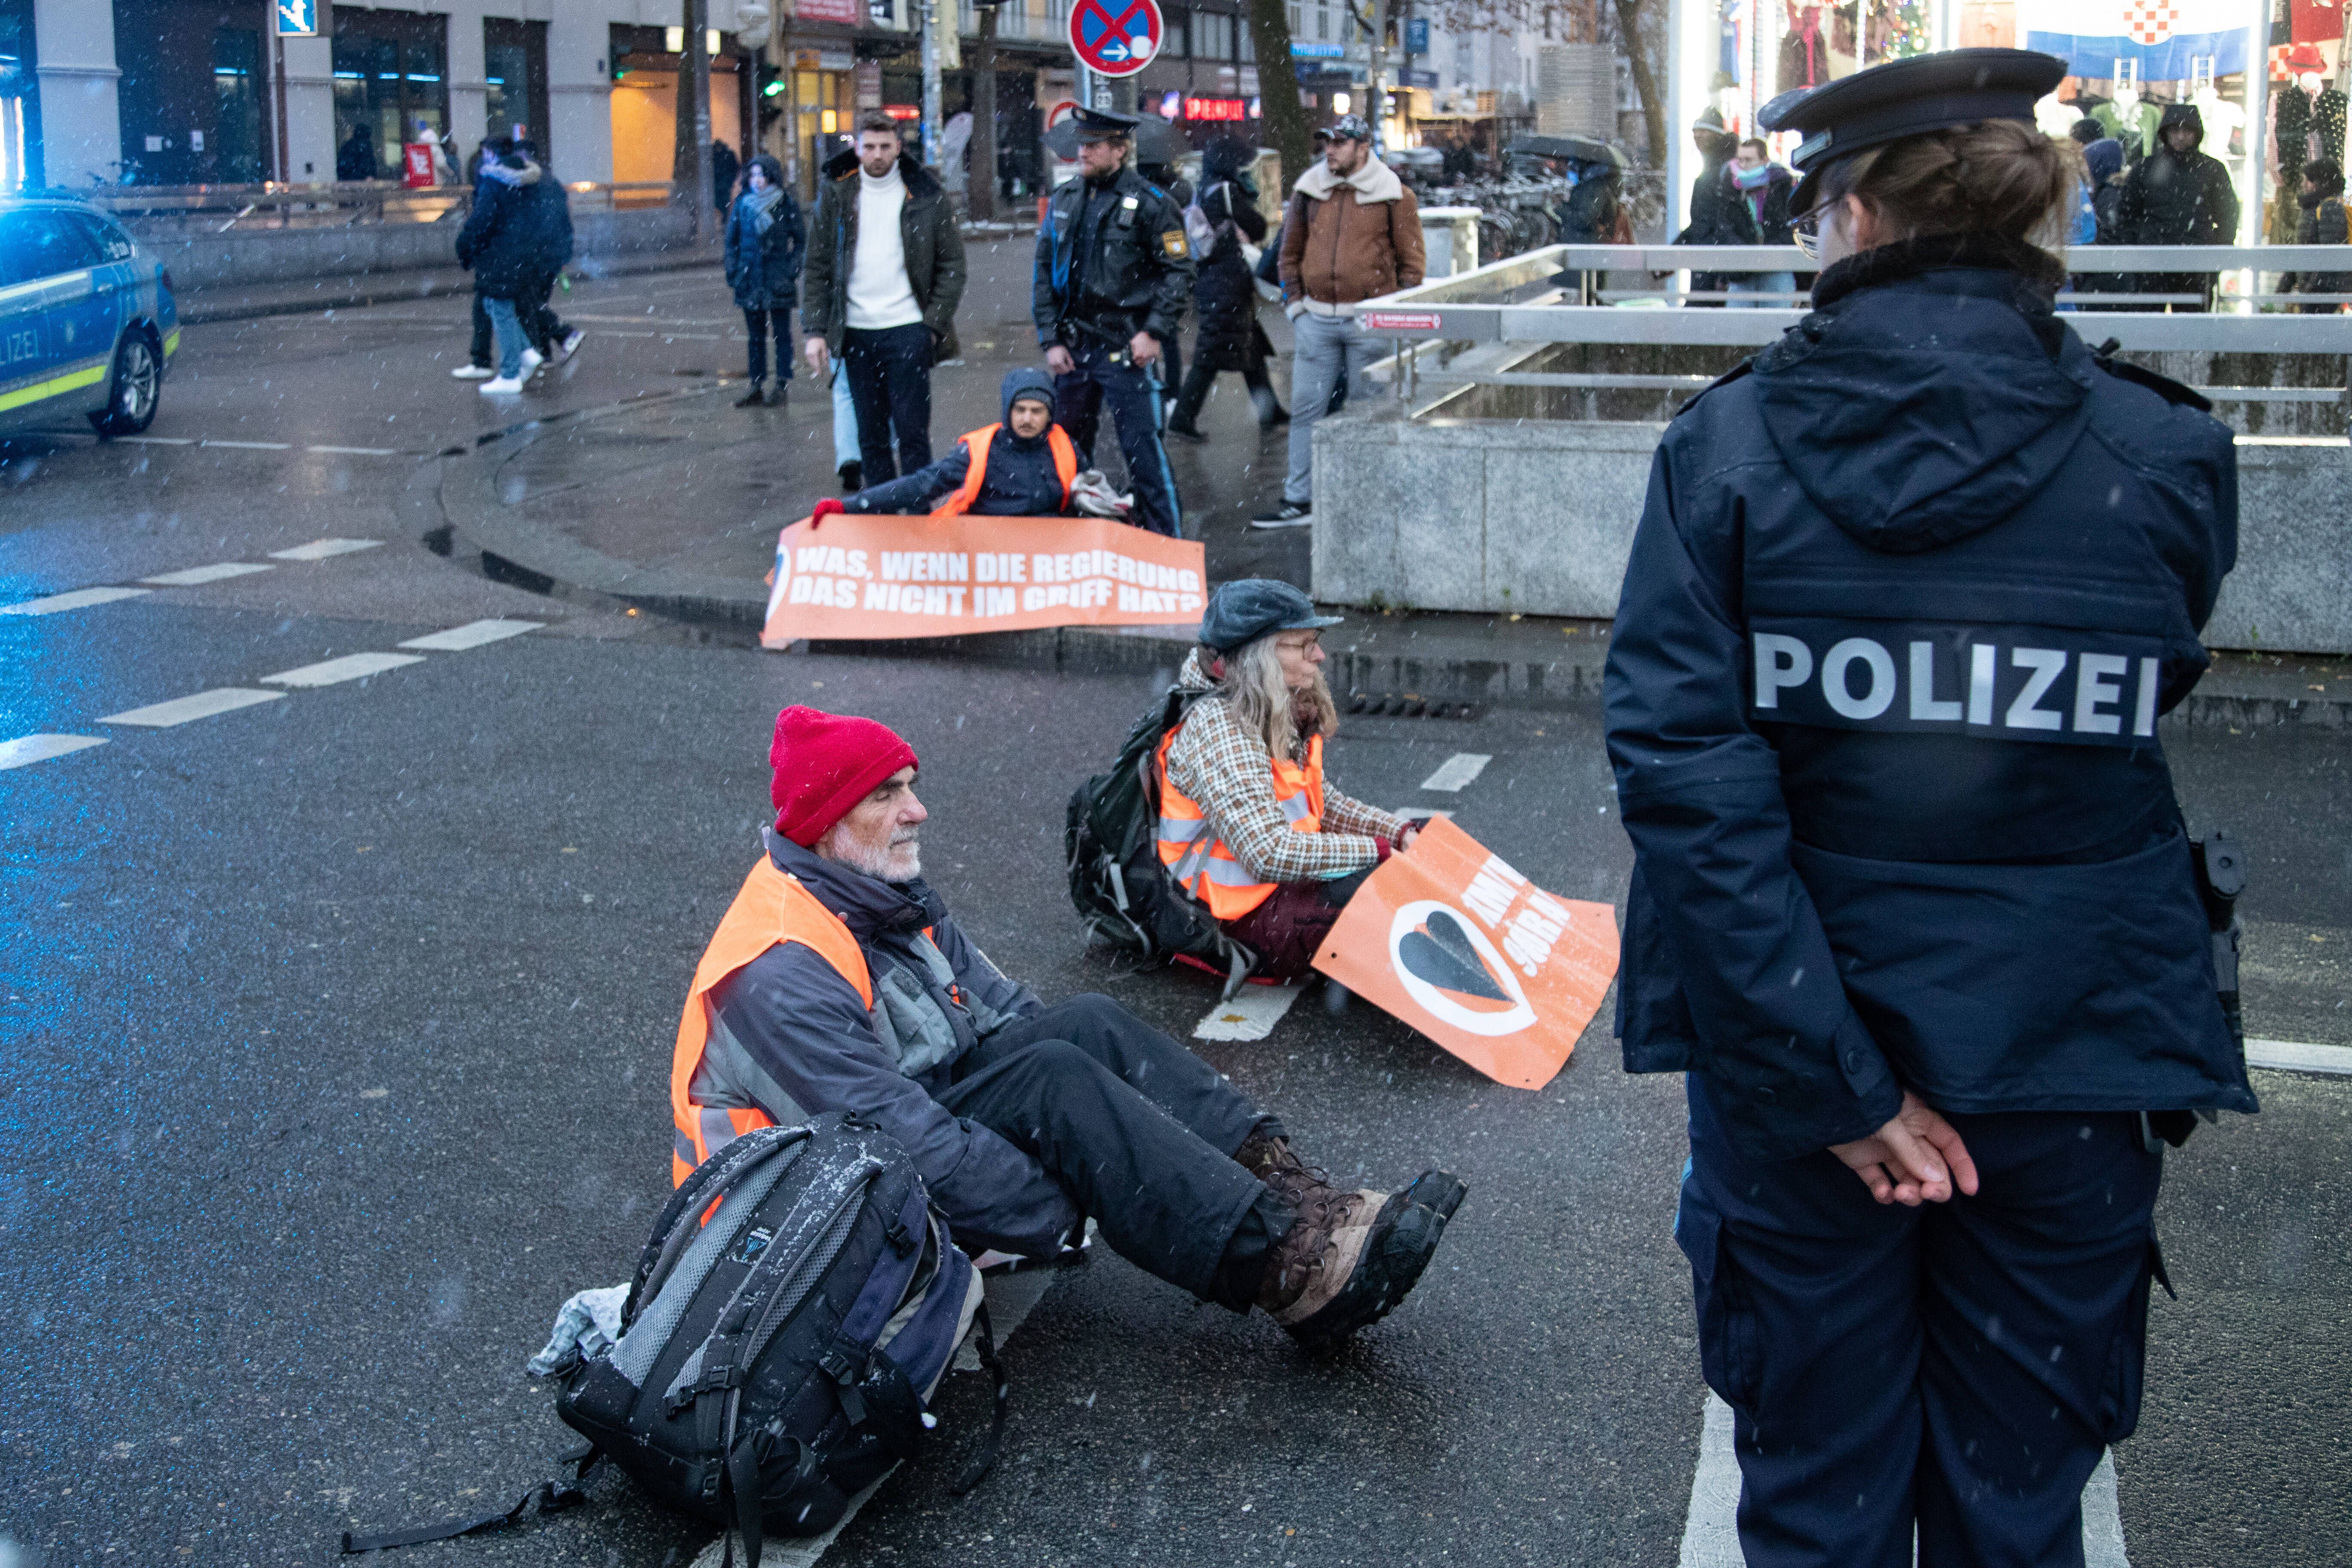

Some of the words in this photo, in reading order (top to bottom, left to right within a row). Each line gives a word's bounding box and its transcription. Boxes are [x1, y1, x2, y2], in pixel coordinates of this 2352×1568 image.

[796, 545, 873, 580] WAS,
[881, 551, 968, 582] WENN
[976, 552, 1027, 582] DIE
[1033, 549, 1200, 593] REGIERUNG
[790, 576, 858, 609] DAS
[864, 582, 967, 616] NICHT
[974, 586, 1016, 617] IM
[1024, 578, 1113, 612] GRIFF
[1118, 584, 1202, 612] HAT?
[1752, 631, 2159, 737] POLIZEI
